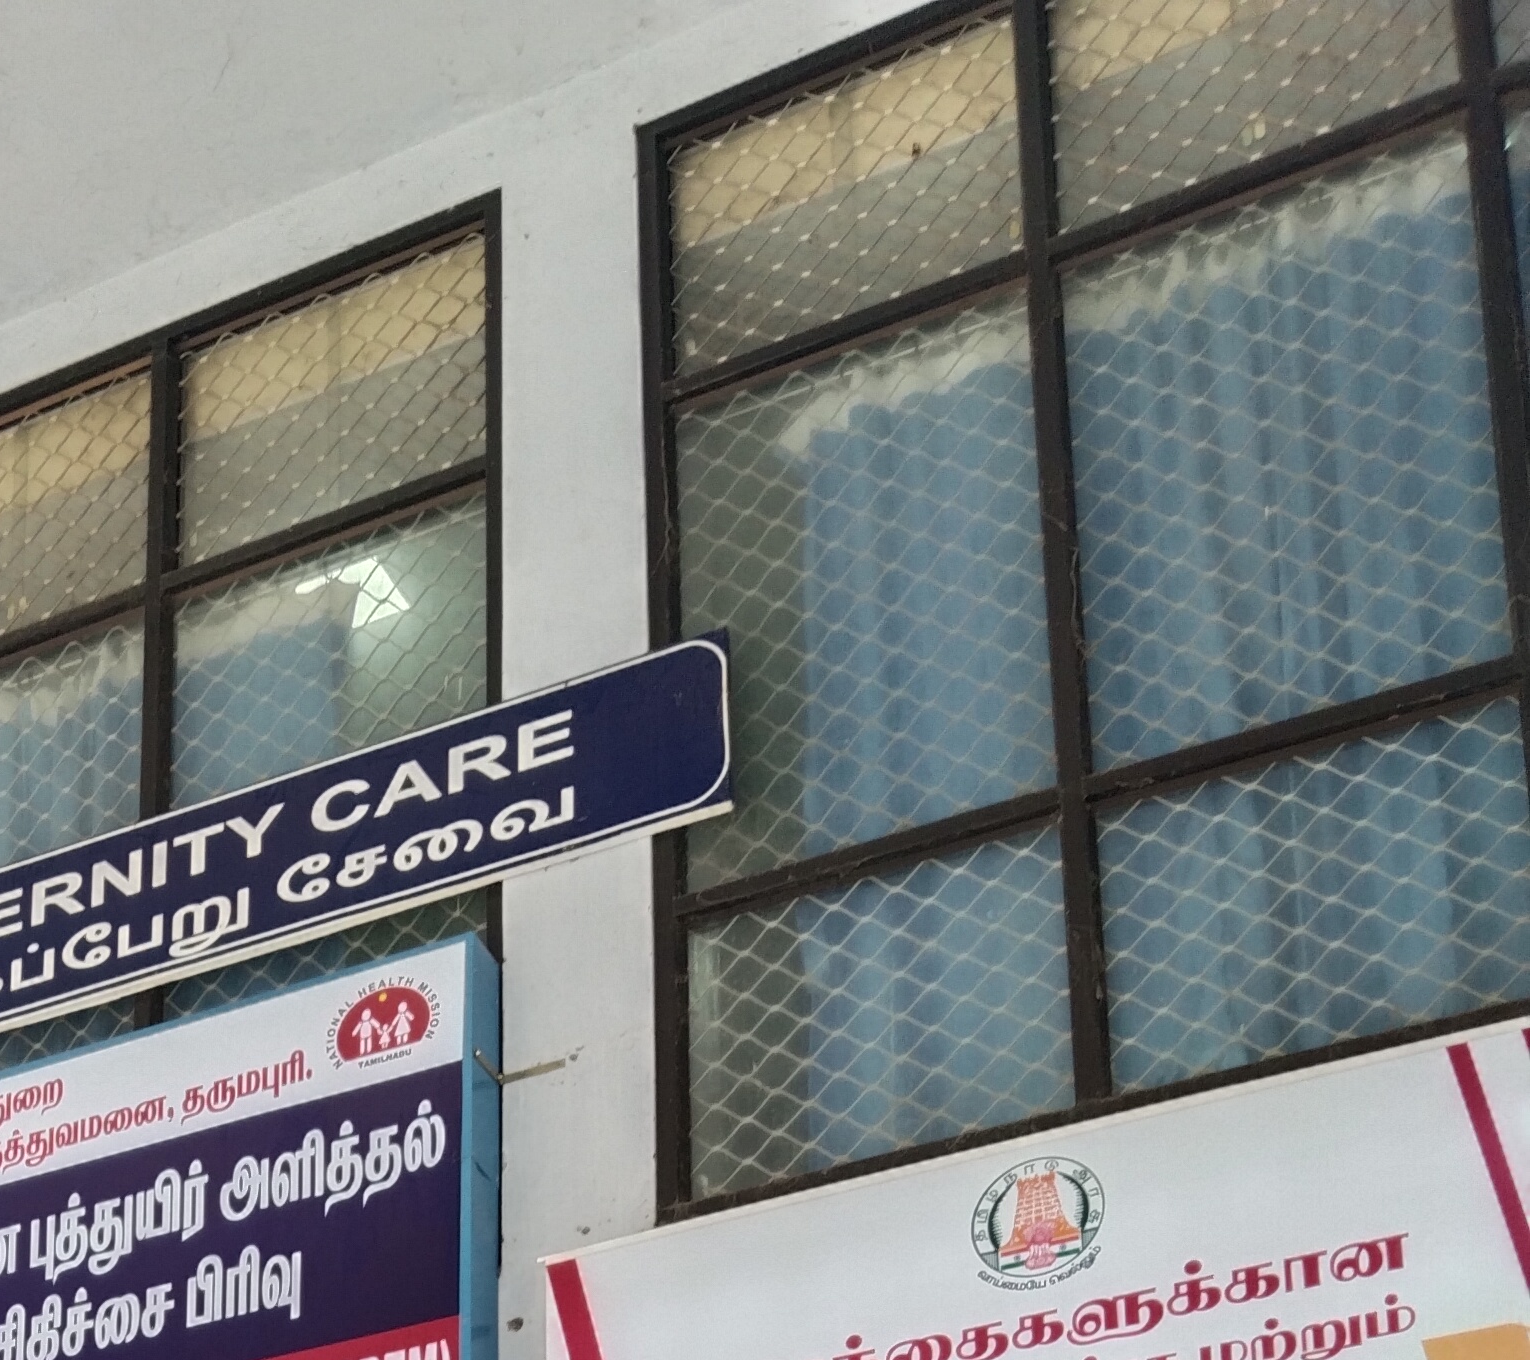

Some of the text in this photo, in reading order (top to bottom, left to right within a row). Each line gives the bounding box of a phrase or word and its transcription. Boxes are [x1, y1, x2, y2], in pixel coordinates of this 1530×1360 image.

[310, 709, 573, 831] CARE
[279, 788, 574, 908] சேவை
[326, 976, 441, 1070] NATIONAL HEALTH MISSION
[181, 1049, 311, 1124] தருமபுரி.
[29, 1159, 208, 1282] புத்துயிர்
[220, 1099, 445, 1220] அளித்தல்
[186, 1243, 300, 1327] பிரிவு
